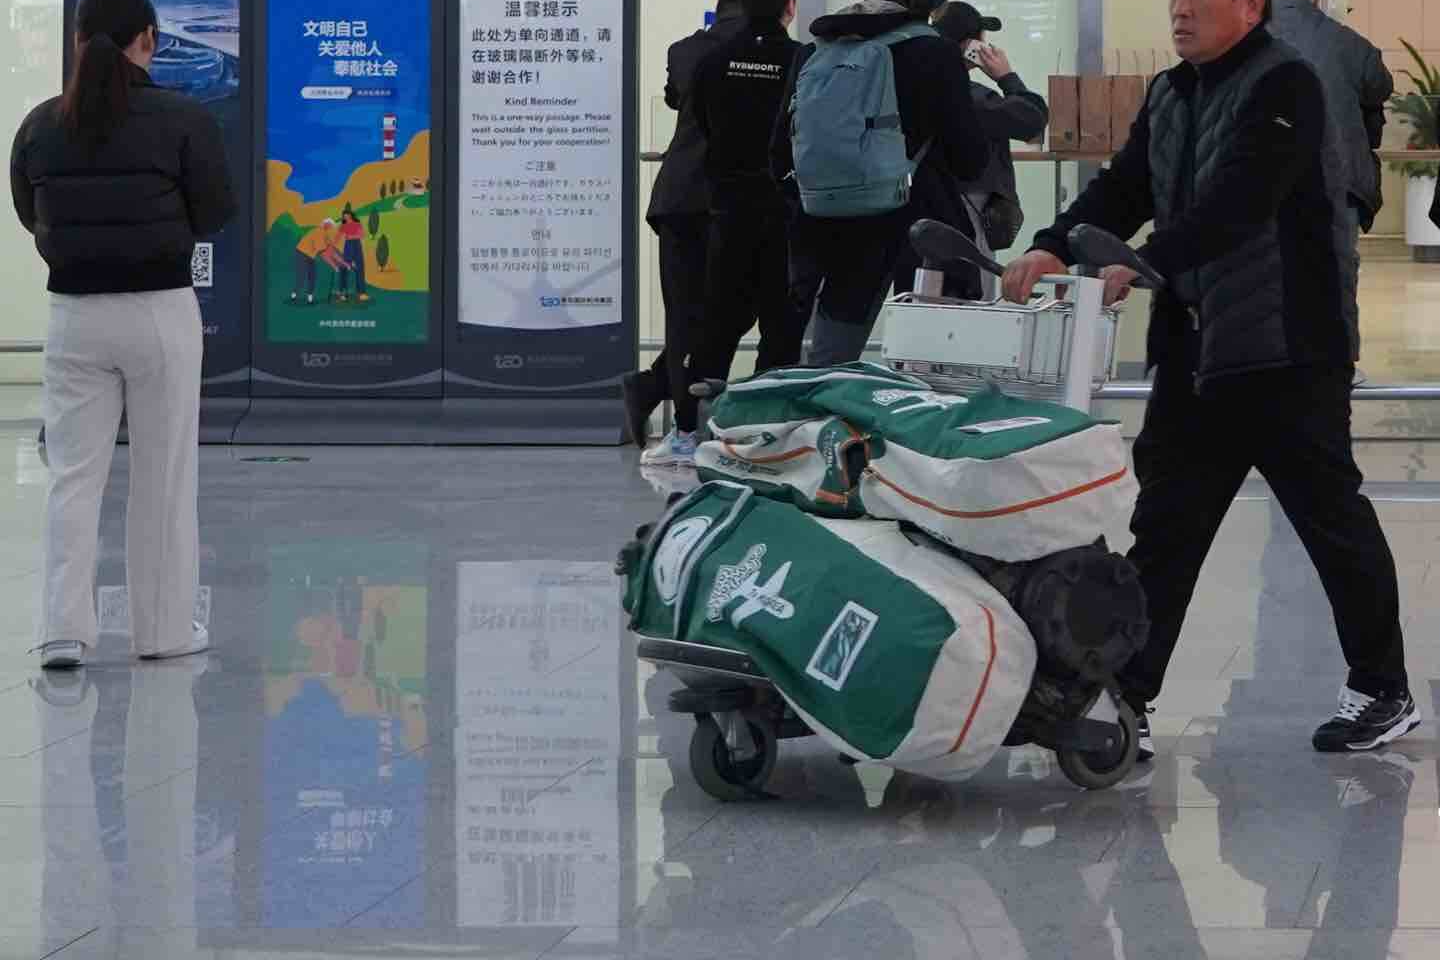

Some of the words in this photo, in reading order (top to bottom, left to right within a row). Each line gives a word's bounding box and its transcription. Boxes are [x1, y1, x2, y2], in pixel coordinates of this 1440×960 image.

[505, 0, 578, 17] 温馨提示
[303, 20, 368, 37] 文明自己
[318, 40, 383, 57] 关爱他人
[333, 60, 398, 77] 奉献社会
